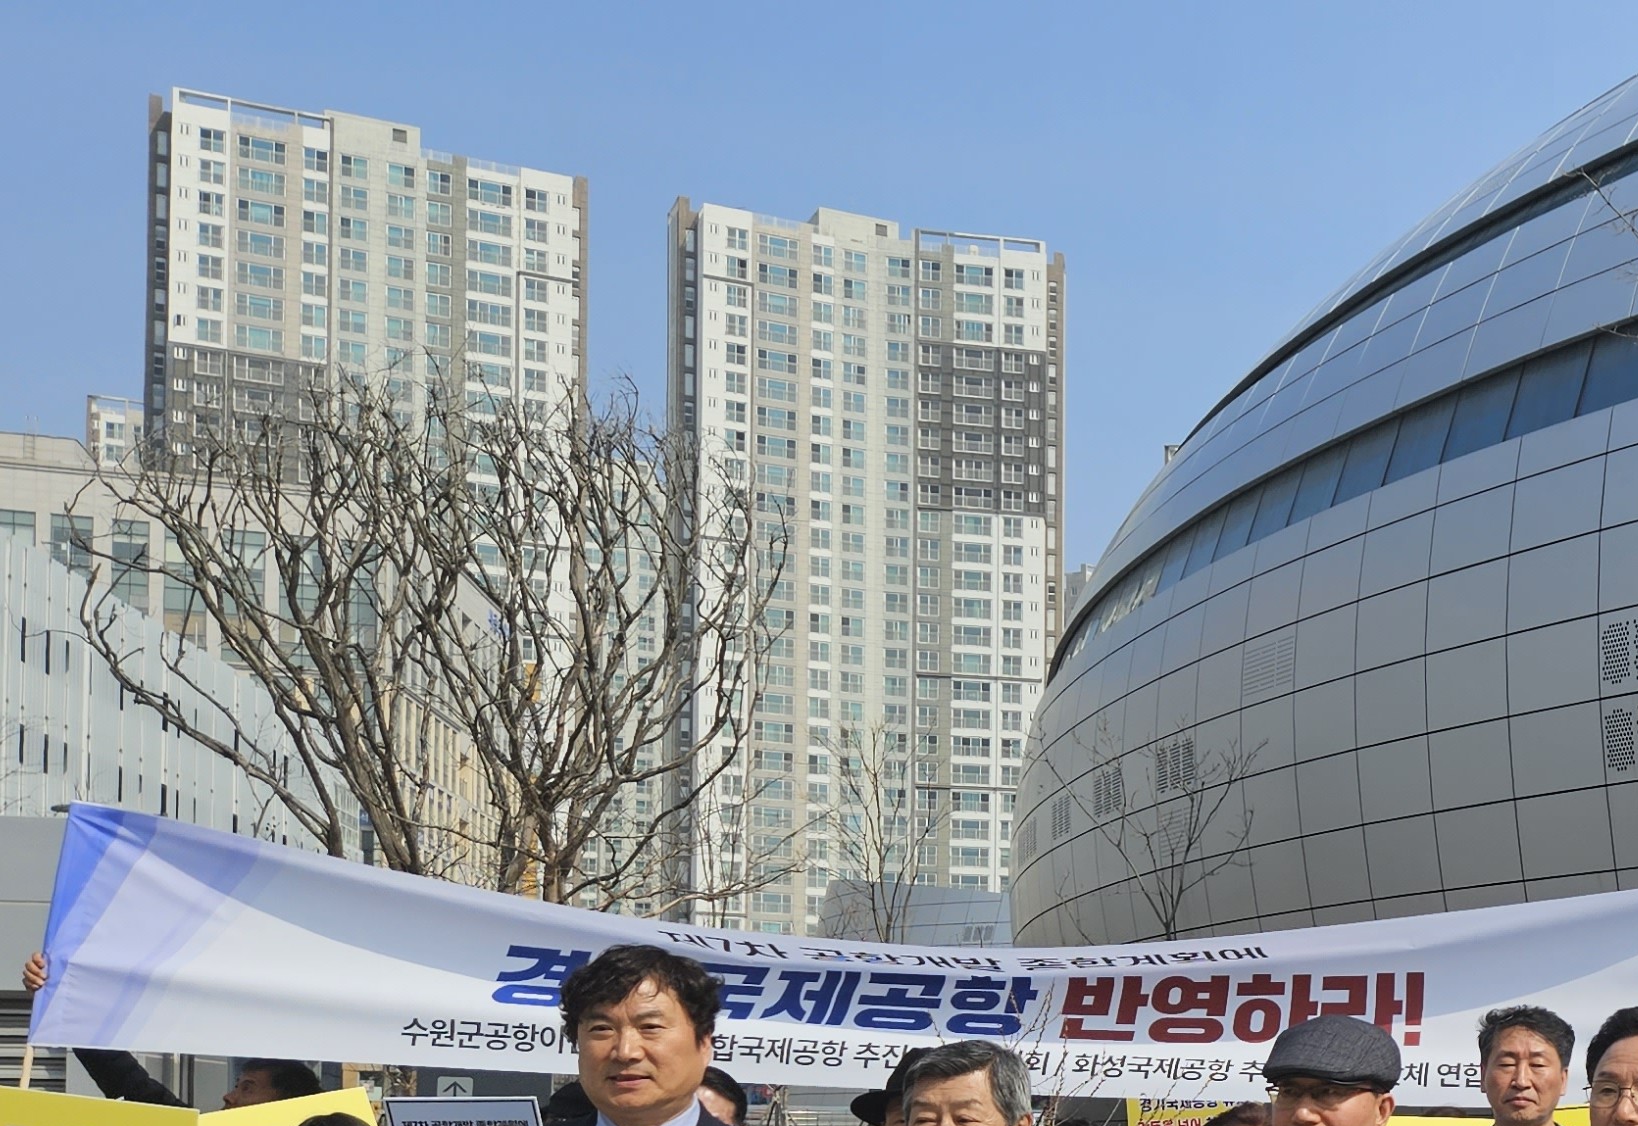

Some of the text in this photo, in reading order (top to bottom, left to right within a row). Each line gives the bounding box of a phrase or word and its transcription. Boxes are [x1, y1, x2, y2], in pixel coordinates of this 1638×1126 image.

[658, 930, 1269, 972] 제7차 공항개발 종합계획에
[492, 945, 1426, 1047] 경국제공항 반영하라!
[401, 1017, 579, 1055] 수원군공항이
[712, 1034, 849, 1067] 합국제공항
[1073, 1052, 1234, 1082] 화성국제공항
